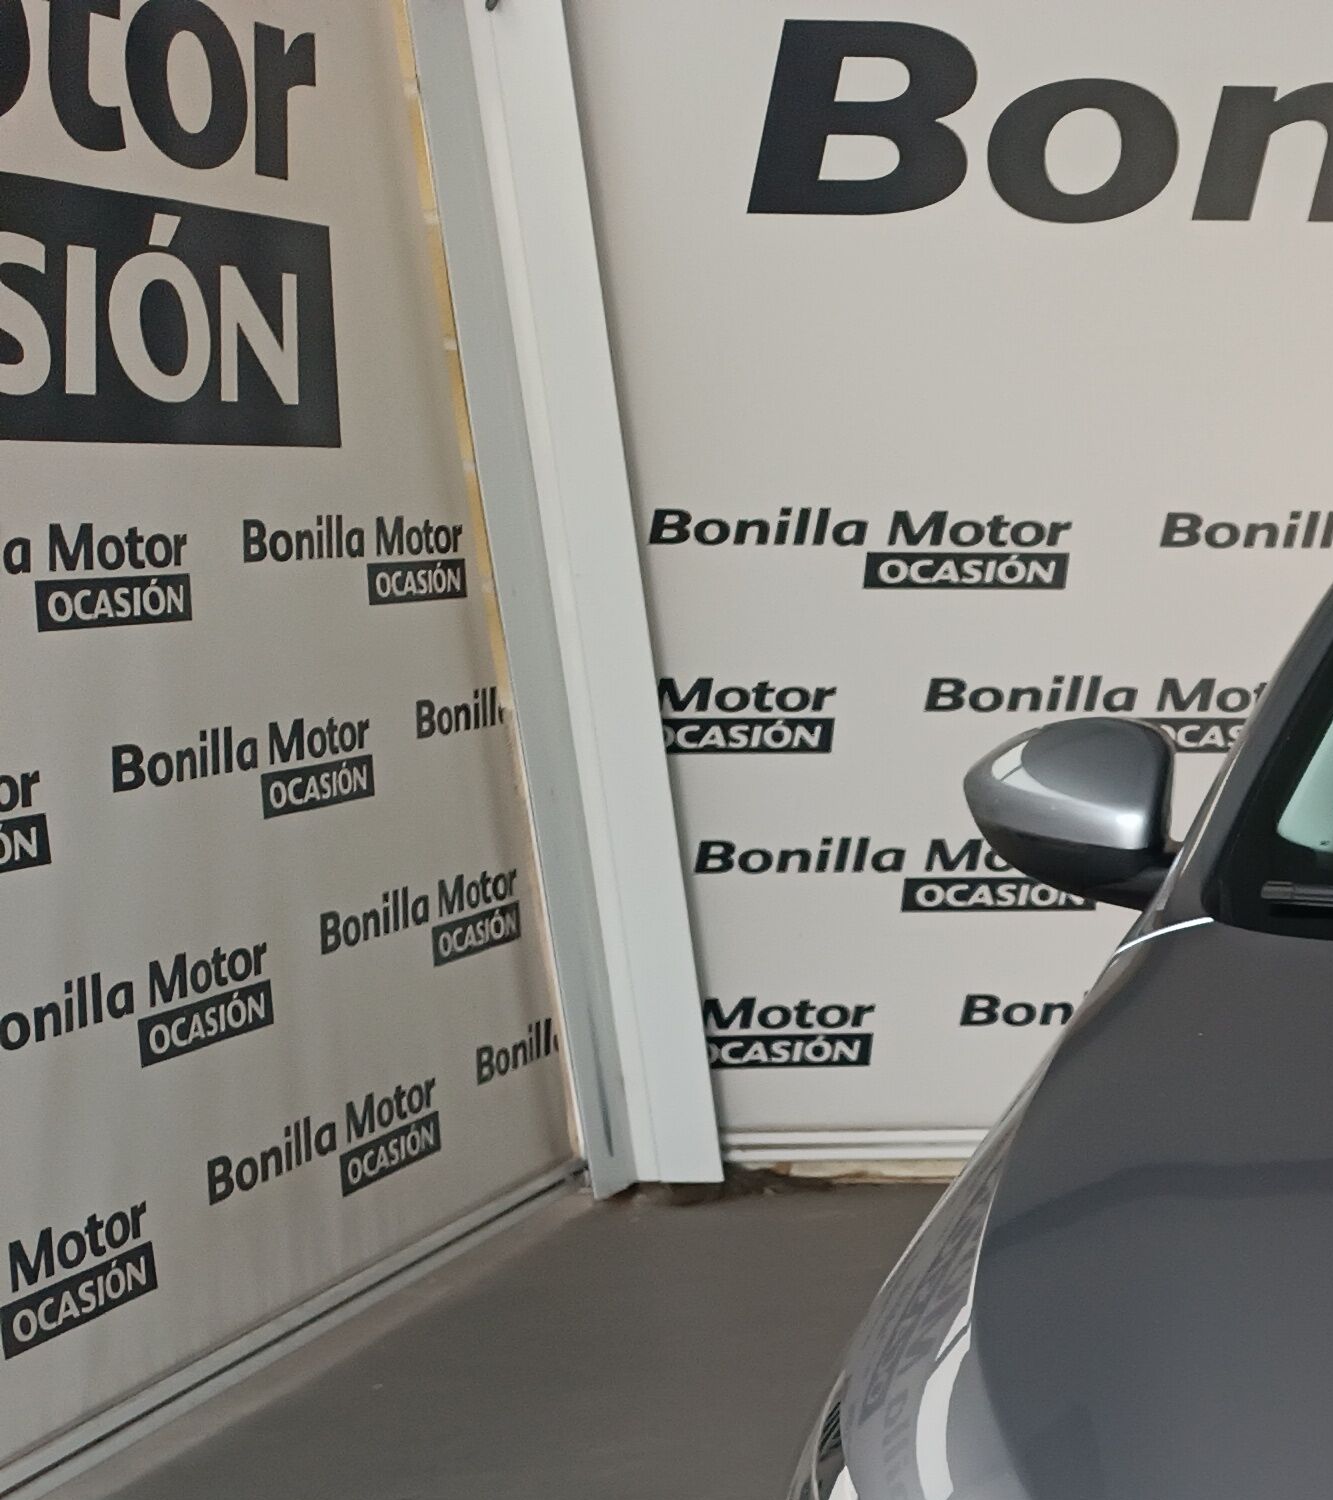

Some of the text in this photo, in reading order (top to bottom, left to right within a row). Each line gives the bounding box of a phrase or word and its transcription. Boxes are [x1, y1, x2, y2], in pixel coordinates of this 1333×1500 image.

[0, 0, 316, 181] tor
[49, 523, 187, 572] Motor
[243, 515, 462, 563] Bonilla Motor
[646, 508, 1072, 547] Bonilla Motor
[376, 562, 460, 597] OCASIÓN
[879, 555, 1056, 583] OCASIÓN
[48, 579, 183, 621] OCASIÓN
[658, 677, 837, 712] Motor
[925, 675, 1138, 712] Bonilla
[112, 718, 369, 793] Bonilla Motor
[270, 762, 366, 808] OCASIÓN
[693, 837, 905, 874] Bonilla
[320, 869, 517, 955] Bonilla Motor
[439, 909, 516, 957] OCASIÓN
[0, 942, 267, 1050] onilla Motor
[703, 998, 875, 1029] Motor
[150, 992, 265, 1054] OCASIÓN
[207, 1078, 435, 1205] Bonilla Motor
[348, 1122, 434, 1184] OCASIÓN
[9, 1201, 146, 1293] Motor
[13, 1255, 147, 1341] OCASIÓN
